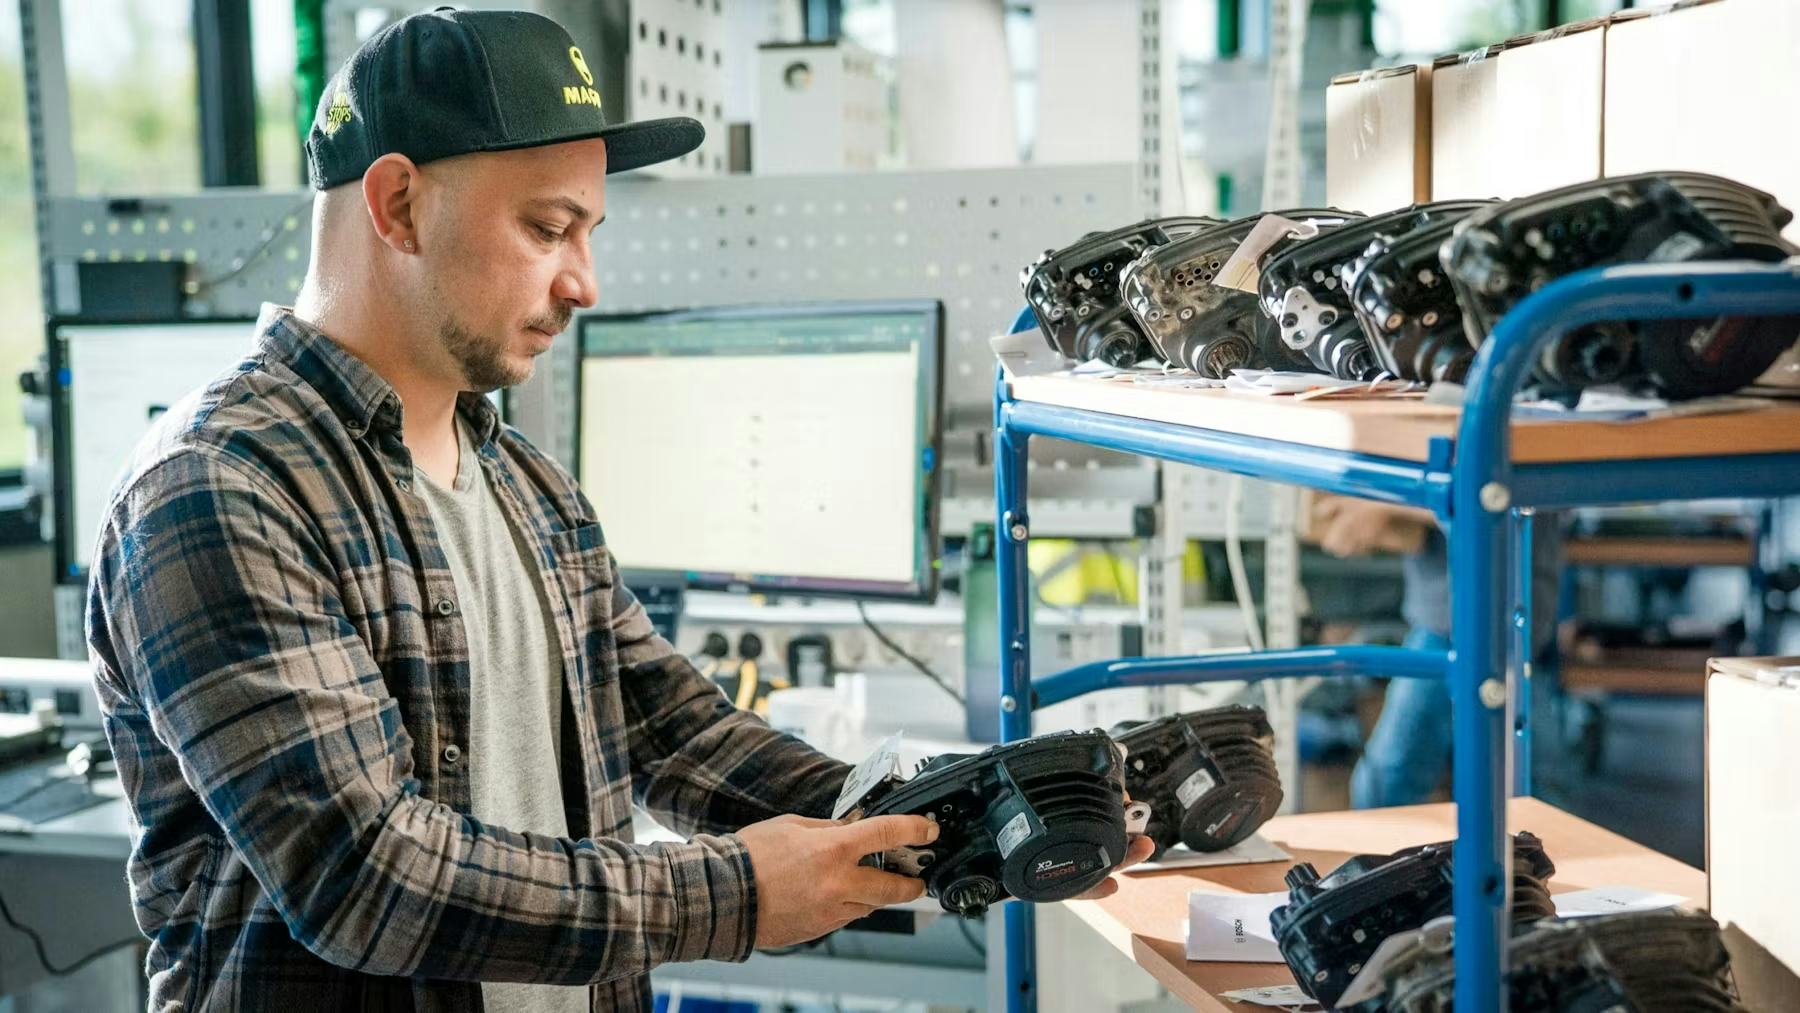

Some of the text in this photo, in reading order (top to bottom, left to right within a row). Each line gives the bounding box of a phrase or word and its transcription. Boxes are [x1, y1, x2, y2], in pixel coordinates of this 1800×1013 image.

[327, 106, 351, 122] STOPS
[1037, 860, 1052, 870] CX
[1234, 918, 1244, 936] BOSCH
